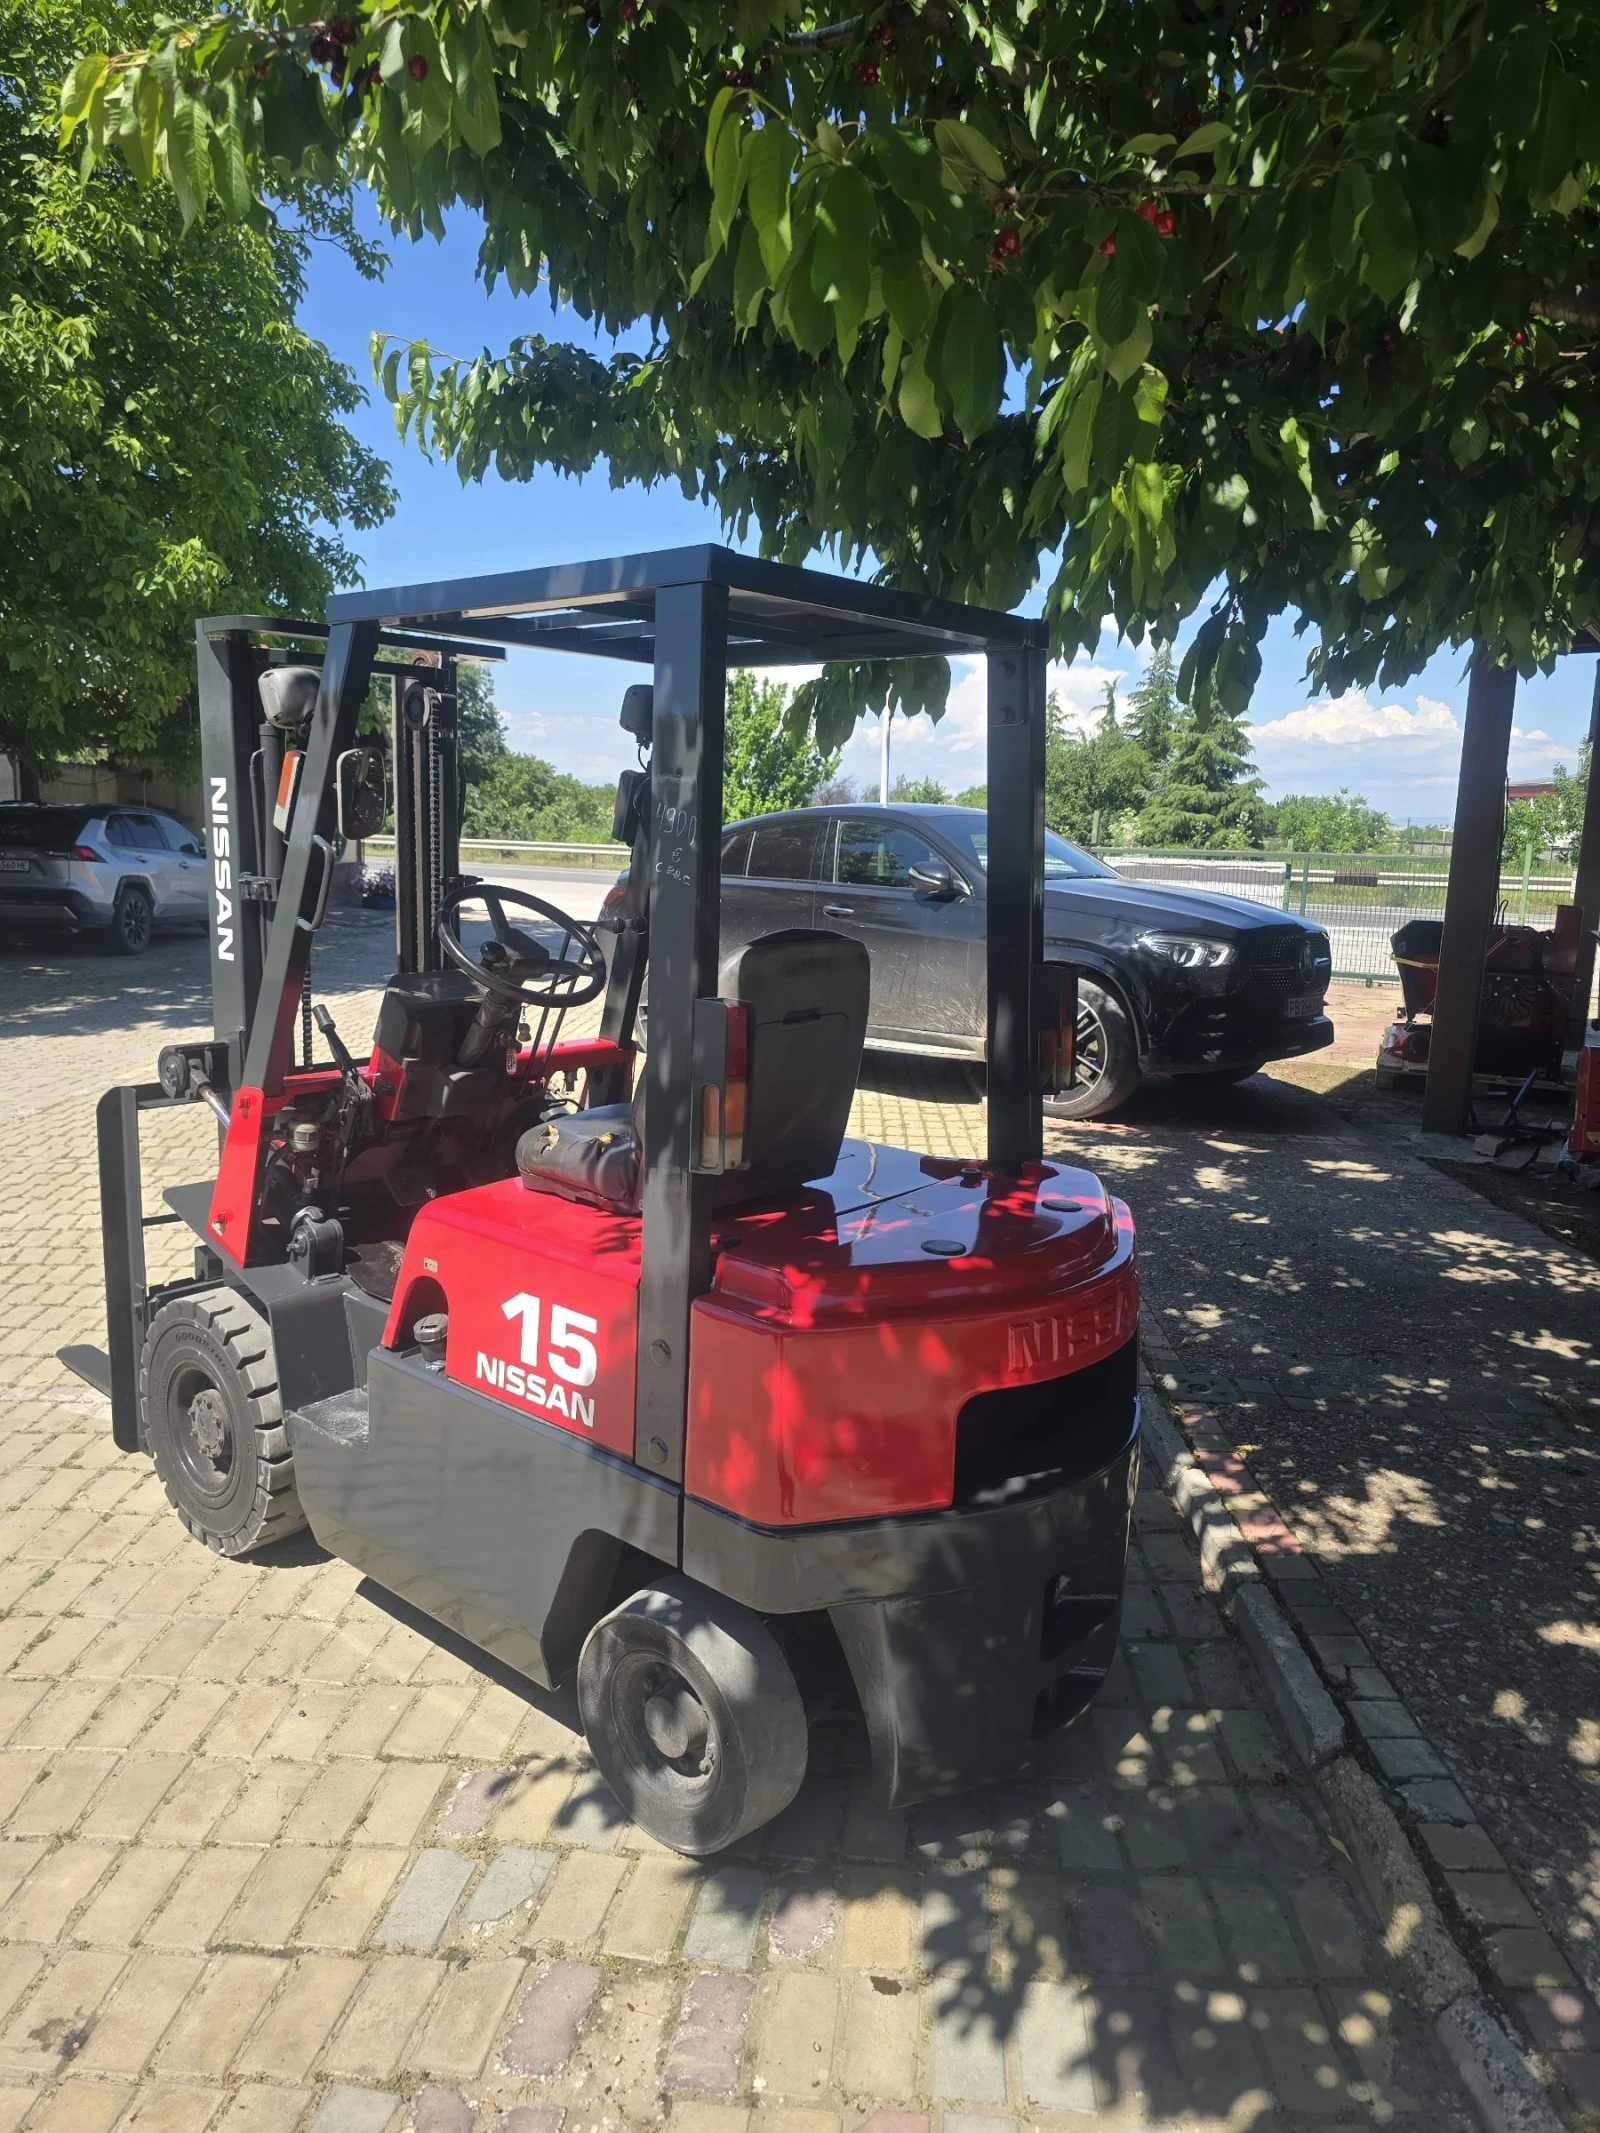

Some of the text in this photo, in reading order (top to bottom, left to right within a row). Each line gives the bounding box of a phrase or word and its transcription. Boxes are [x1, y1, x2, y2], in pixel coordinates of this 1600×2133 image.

[0, 861, 16, 869] 560
[210, 777, 235, 962] NISSAN
[501, 1292, 597, 1387] 15
[476, 1351, 594, 1428] NISSAN
